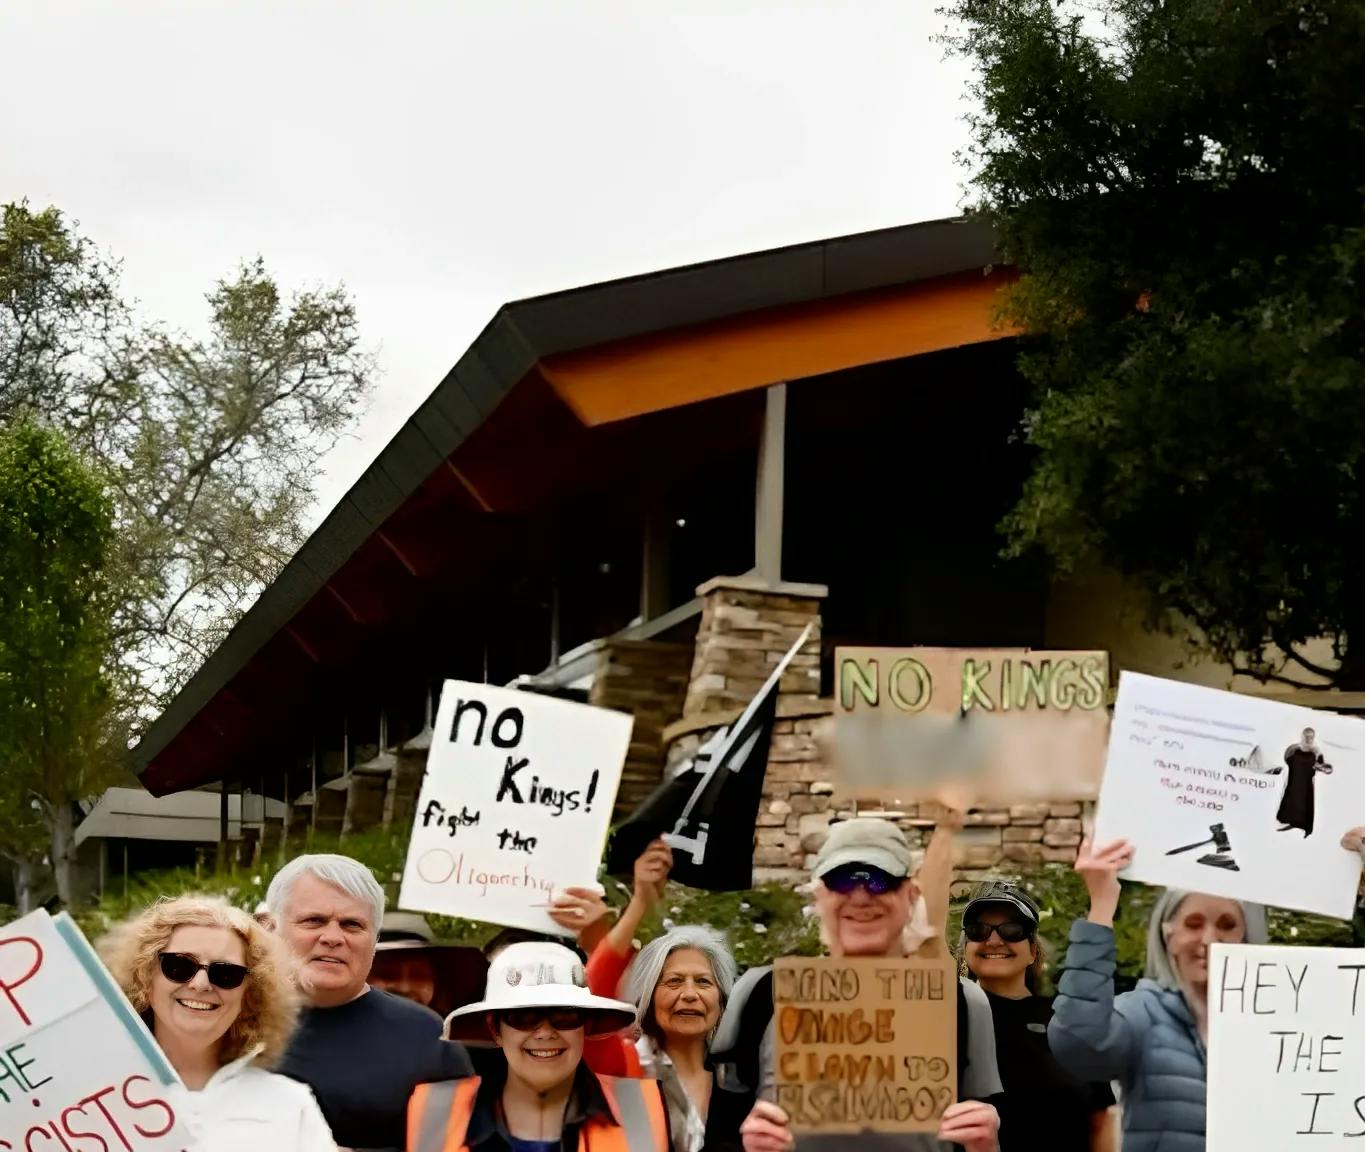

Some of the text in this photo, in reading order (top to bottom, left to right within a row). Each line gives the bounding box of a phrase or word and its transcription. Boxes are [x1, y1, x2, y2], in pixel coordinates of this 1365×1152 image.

[840, 657, 1106, 713] NO KINGS
[496, 755, 600, 817] Kings!
[1219, 955, 1308, 1015] HEY
[1270, 1031, 1344, 1074] THE
